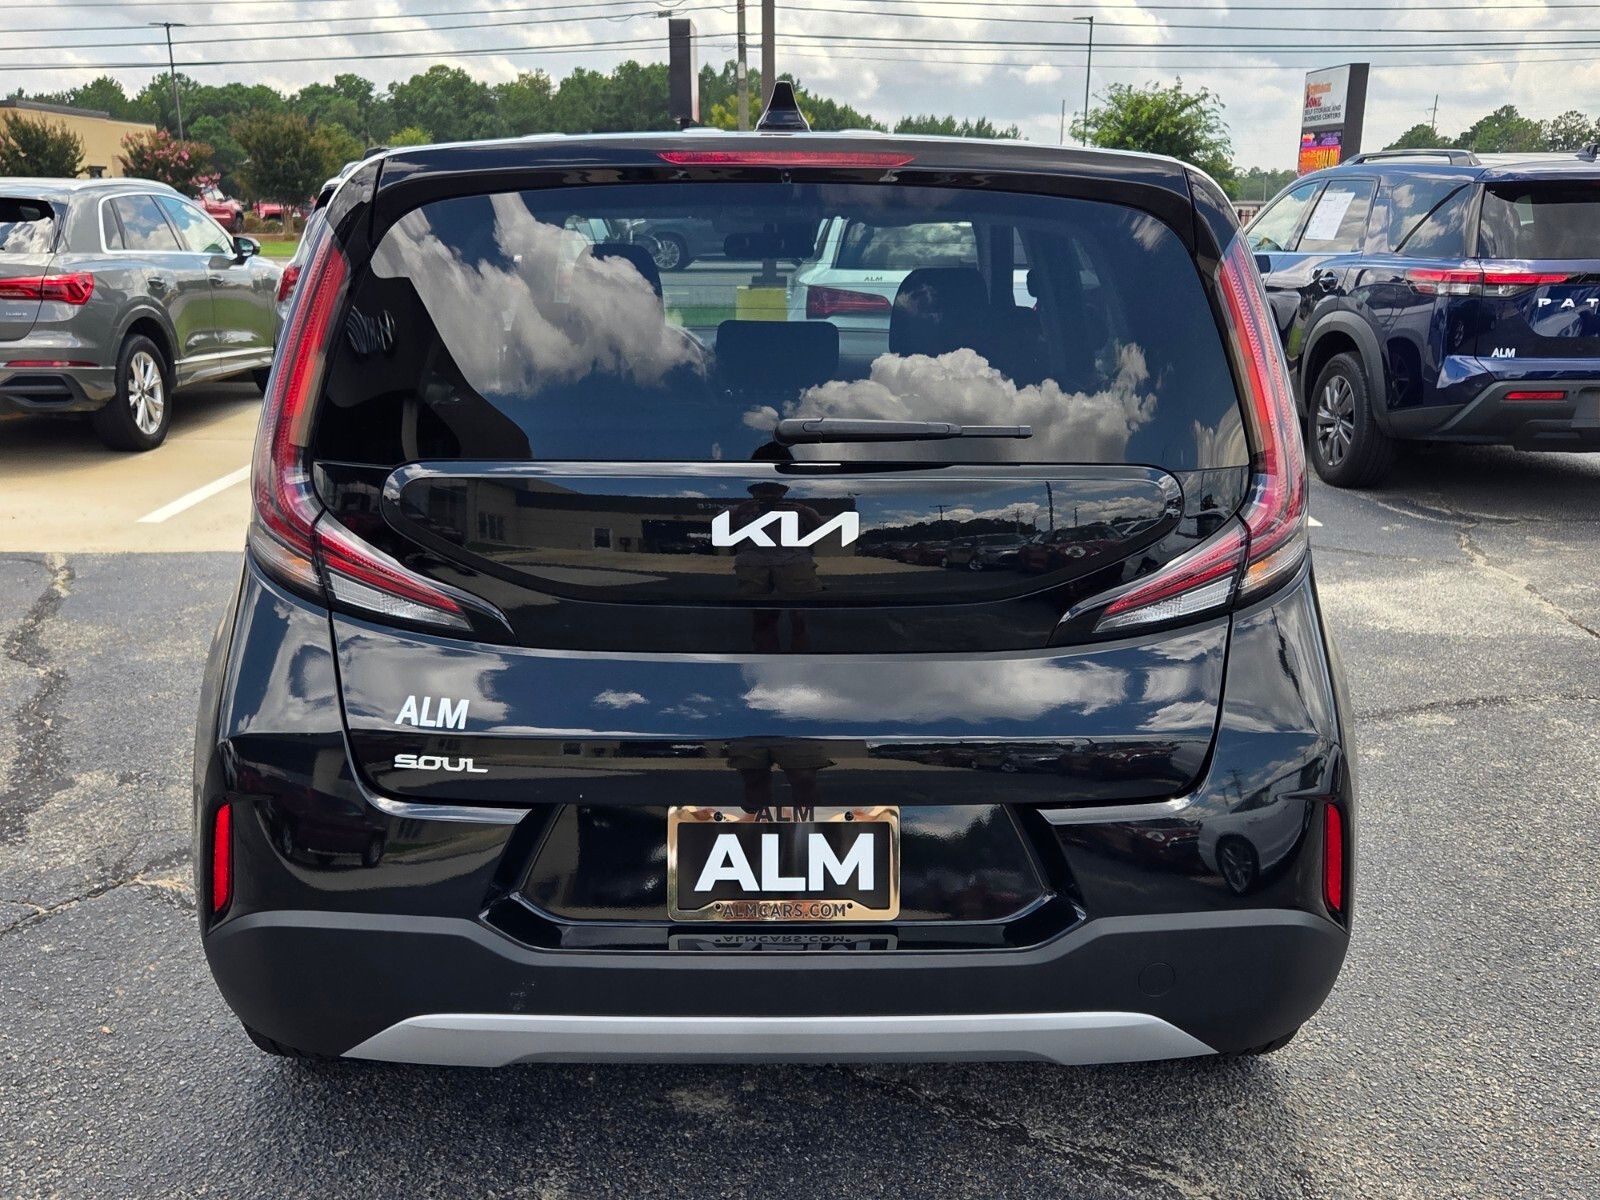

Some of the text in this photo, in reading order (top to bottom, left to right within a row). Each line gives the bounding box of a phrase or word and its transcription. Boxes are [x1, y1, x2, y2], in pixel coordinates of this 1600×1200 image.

[1538, 298, 1599, 308] PAT
[1491, 347, 1516, 358] ALM
[711, 510, 860, 547] KIA
[394, 695, 470, 730] ALM
[394, 754, 489, 773] SOUL
[755, 806, 815, 822] ALM
[694, 833, 875, 892] ALM
[722, 903, 846, 917] ALMCARS.COM
